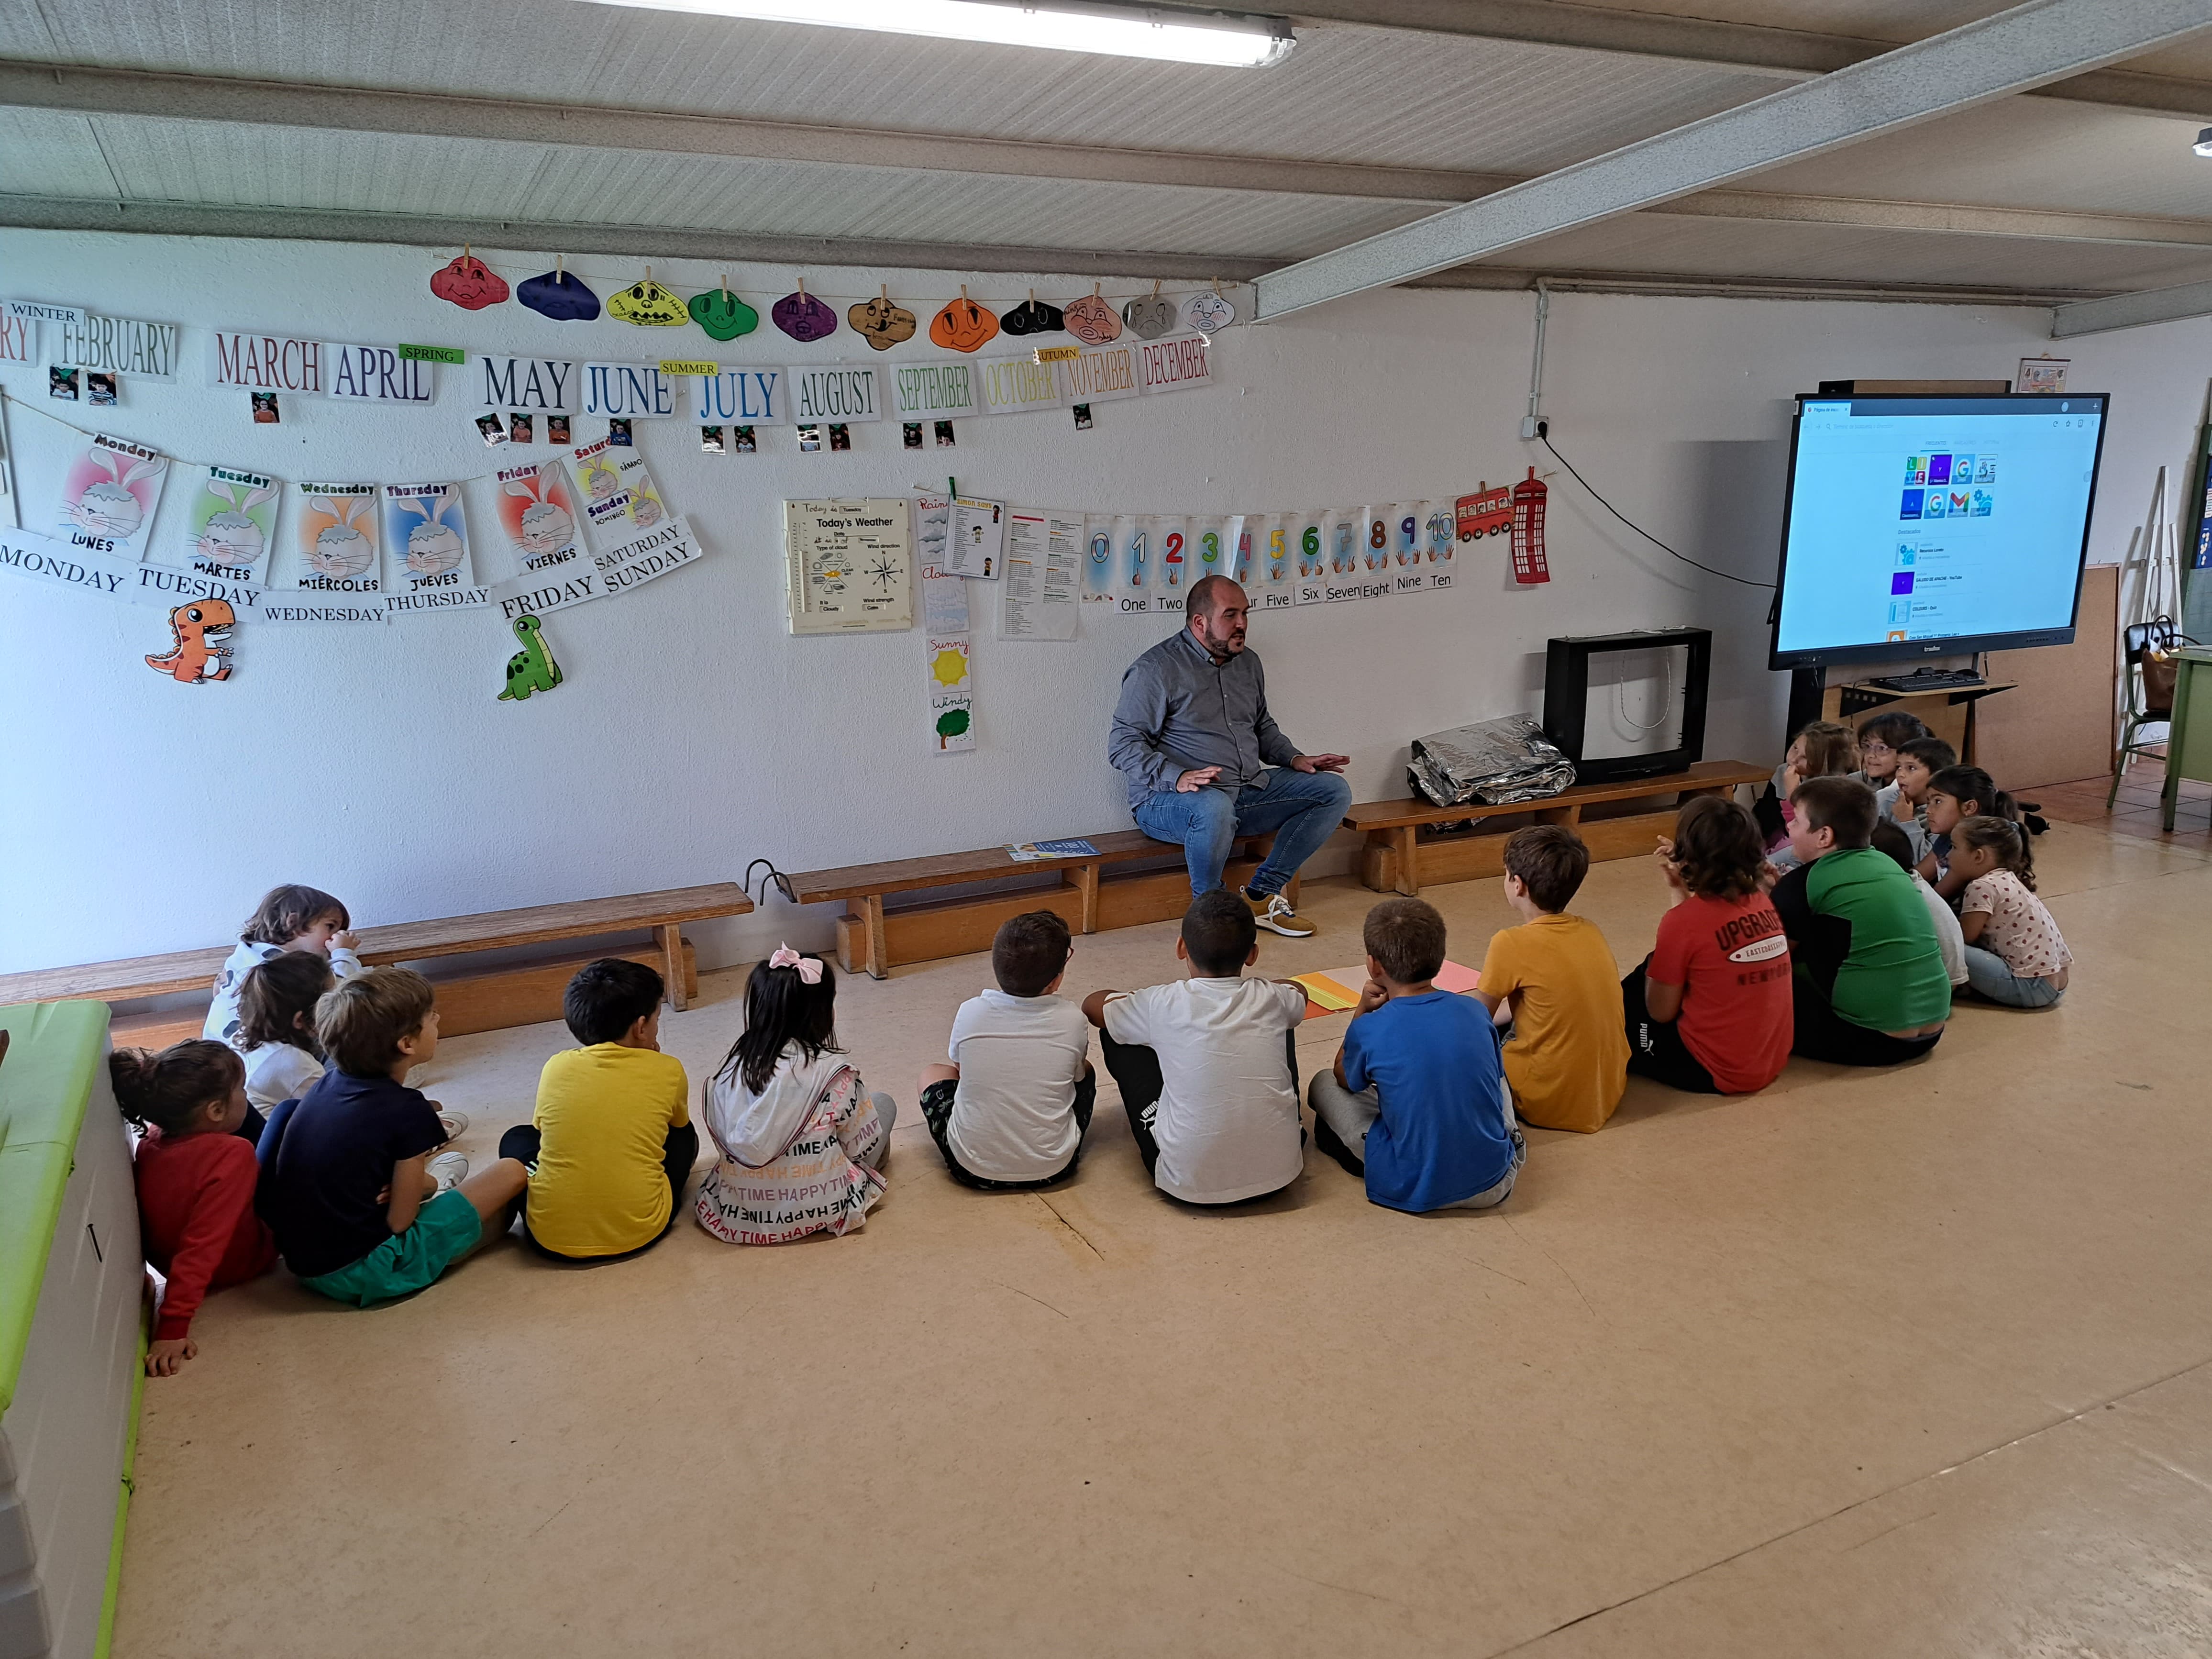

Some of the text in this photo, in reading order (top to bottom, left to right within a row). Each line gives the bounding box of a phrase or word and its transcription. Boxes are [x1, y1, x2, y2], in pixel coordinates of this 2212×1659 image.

[11, 303, 76, 322] WINTER
[62, 315, 174, 376] FEBRUARY
[405, 347, 454, 362] SPRING
[215, 332, 321, 392] MARCH
[334, 345, 431, 401] APRIL
[662, 363, 716, 375] SUMMER
[1066, 349, 1135, 397] NOVEMBER
[1142, 338, 1209, 386] DECEMBER
[481, 357, 572, 409] MAY
[586, 366, 673, 415] JUNE
[799, 371, 874, 417] AUGUST
[897, 365, 973, 411] SEPTEMBER
[985, 361, 1056, 407] OCTOBER
[700, 373, 779, 419] JULY
[93, 433, 156, 462] Monday
[497, 465, 538, 481] Friday
[619, 458, 642, 471] SÁBADO
[210, 465, 270, 488] Tuesday
[300, 483, 374, 495] Wednesday
[387, 484, 448, 497] Thursday
[587, 493, 630, 518] Sunday
[802, 503, 827, 514] Today
[918, 498, 948, 510] Rain
[957, 498, 975, 507] simon
[977, 500, 992, 509] says
[595, 509, 625, 526] DOMINGO
[816, 518, 894, 529] Today's Weather
[1426, 512, 1454, 542] 10
[1302, 526, 1319, 555] 6
[1337, 523, 1352, 552] 7
[1370, 520, 1386, 549] 8
[1401, 517, 1415, 544] 9
[71, 532, 115, 553] LUNES
[594, 524, 680, 571] SATURDAY
[1091, 532, 1110, 563] 0
[1132, 532, 1146, 563] 1
[1166, 532, 1183, 563] 2
[1202, 532, 1218, 563] 3
[1239, 532, 1251, 561] 4
[1270, 529, 1285, 559] 5
[0, 544, 125, 594] MONDAY
[194, 561, 251, 581] MARTES
[526, 548, 576, 571] VIERNES
[604, 541, 691, 594] SUNDAY
[138, 567, 261, 608] TUESDAY
[299, 575, 378, 592] MIÉRCOLES
[410, 573, 458, 592] JUEVES
[1363, 582, 1390, 598] Eight
[1397, 575, 1421, 589] Nine
[1430, 574, 1451, 586] Ten
[384, 589, 489, 612] THURSDAY
[499, 575, 595, 620] FRIDAY
[1158, 597, 1183, 610] Two
[1266, 594, 1289, 607] Five
[1303, 588, 1319, 600] Six
[1327, 585, 1360, 600] Seven
[265, 607, 383, 622] WEDNESDAY
[1121, 598, 1146, 611] One
[930, 639, 969, 654] Sunny
[933, 693, 972, 709] Windy
[738, 1187, 775, 1201] TIME
[778, 1183, 827, 1201] HAPPY
[740, 1230, 777, 1245] TIME
